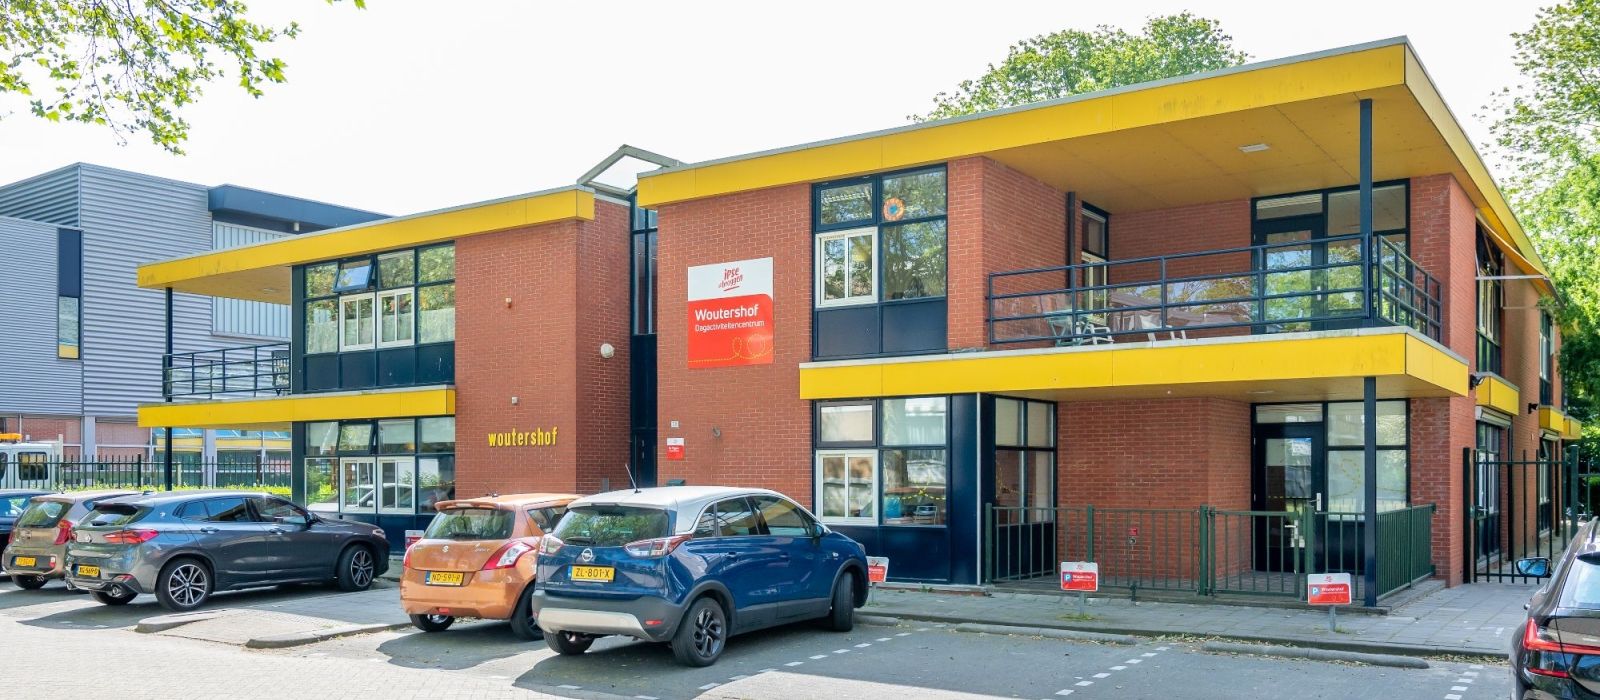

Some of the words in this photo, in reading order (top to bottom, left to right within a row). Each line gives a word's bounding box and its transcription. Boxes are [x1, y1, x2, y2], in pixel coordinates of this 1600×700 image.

[724, 267, 740, 280] ipse
[694, 304, 759, 321] Woutershof
[488, 426, 558, 447] woutershof
[575, 567, 610, 578] ZL-801-X
